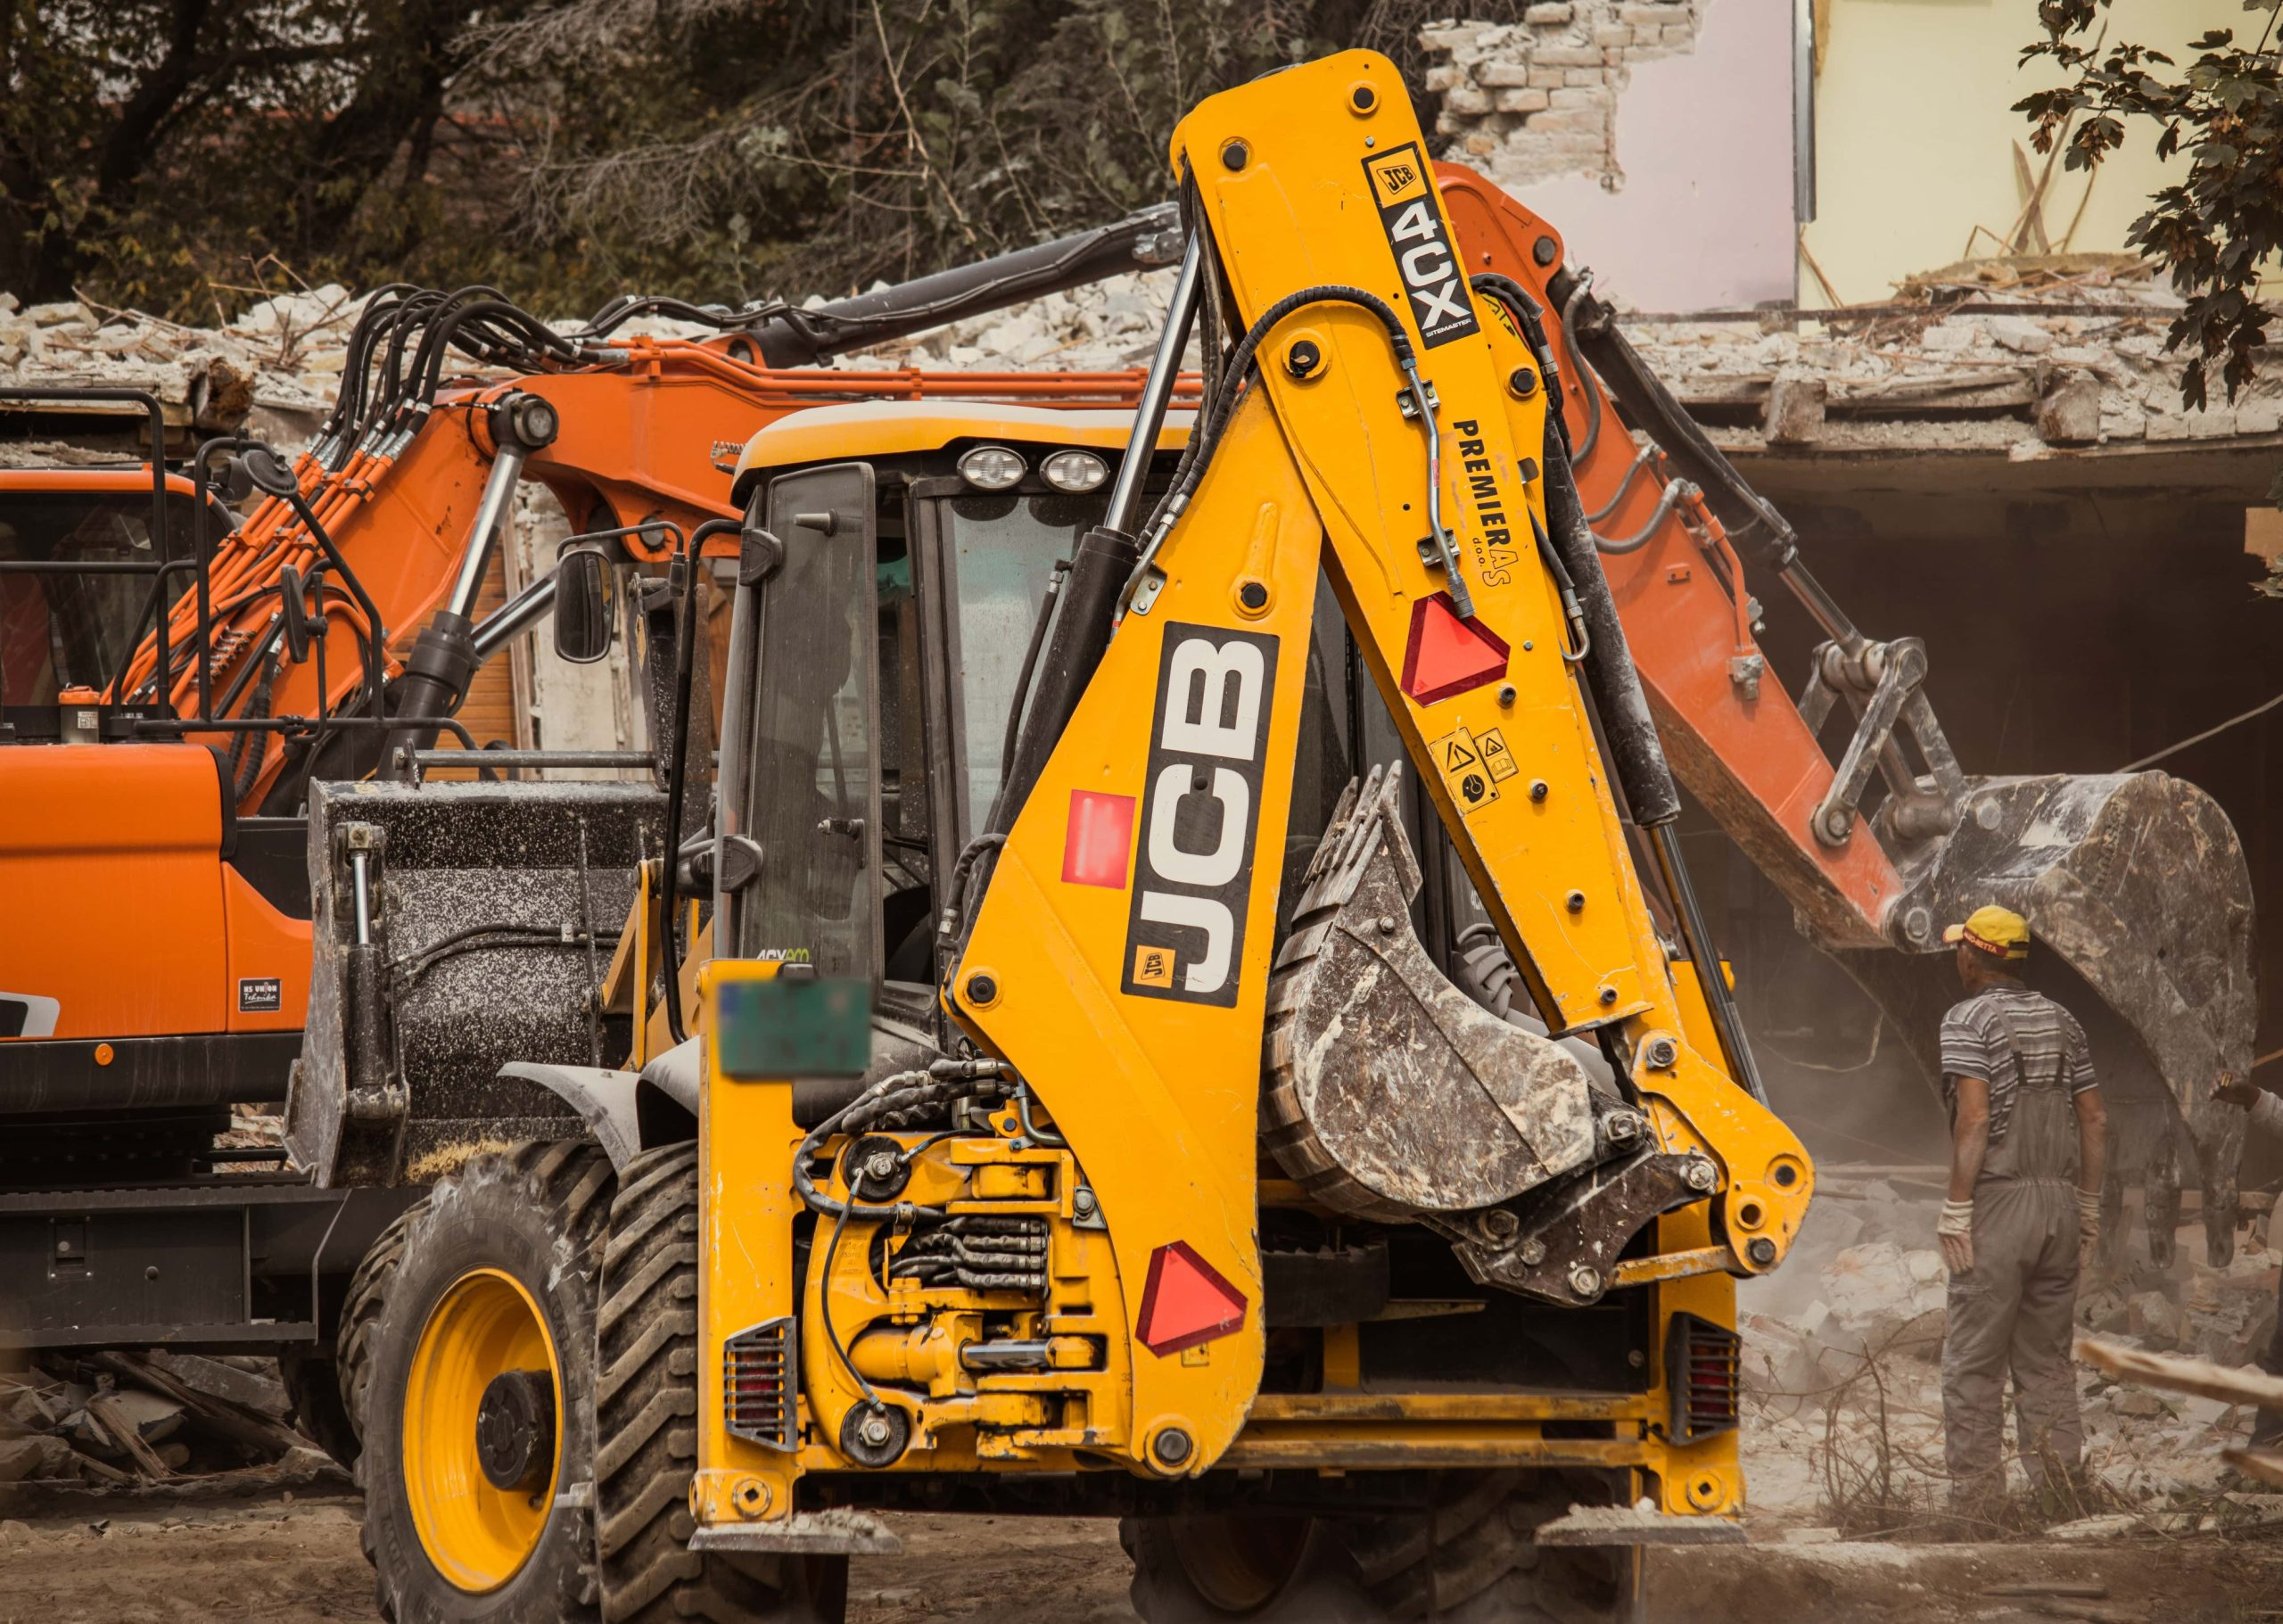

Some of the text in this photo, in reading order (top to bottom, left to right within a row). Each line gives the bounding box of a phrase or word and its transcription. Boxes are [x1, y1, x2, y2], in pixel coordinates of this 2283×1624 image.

[1383, 167, 1413, 191] JCB
[1391, 201, 1471, 330] 4CX
[1425, 317, 1471, 338] SITEMASTER
[1472, 537, 1486, 567] d.o.o.
[1140, 639, 1265, 993] JCB
[1144, 954, 1163, 976] JCB
